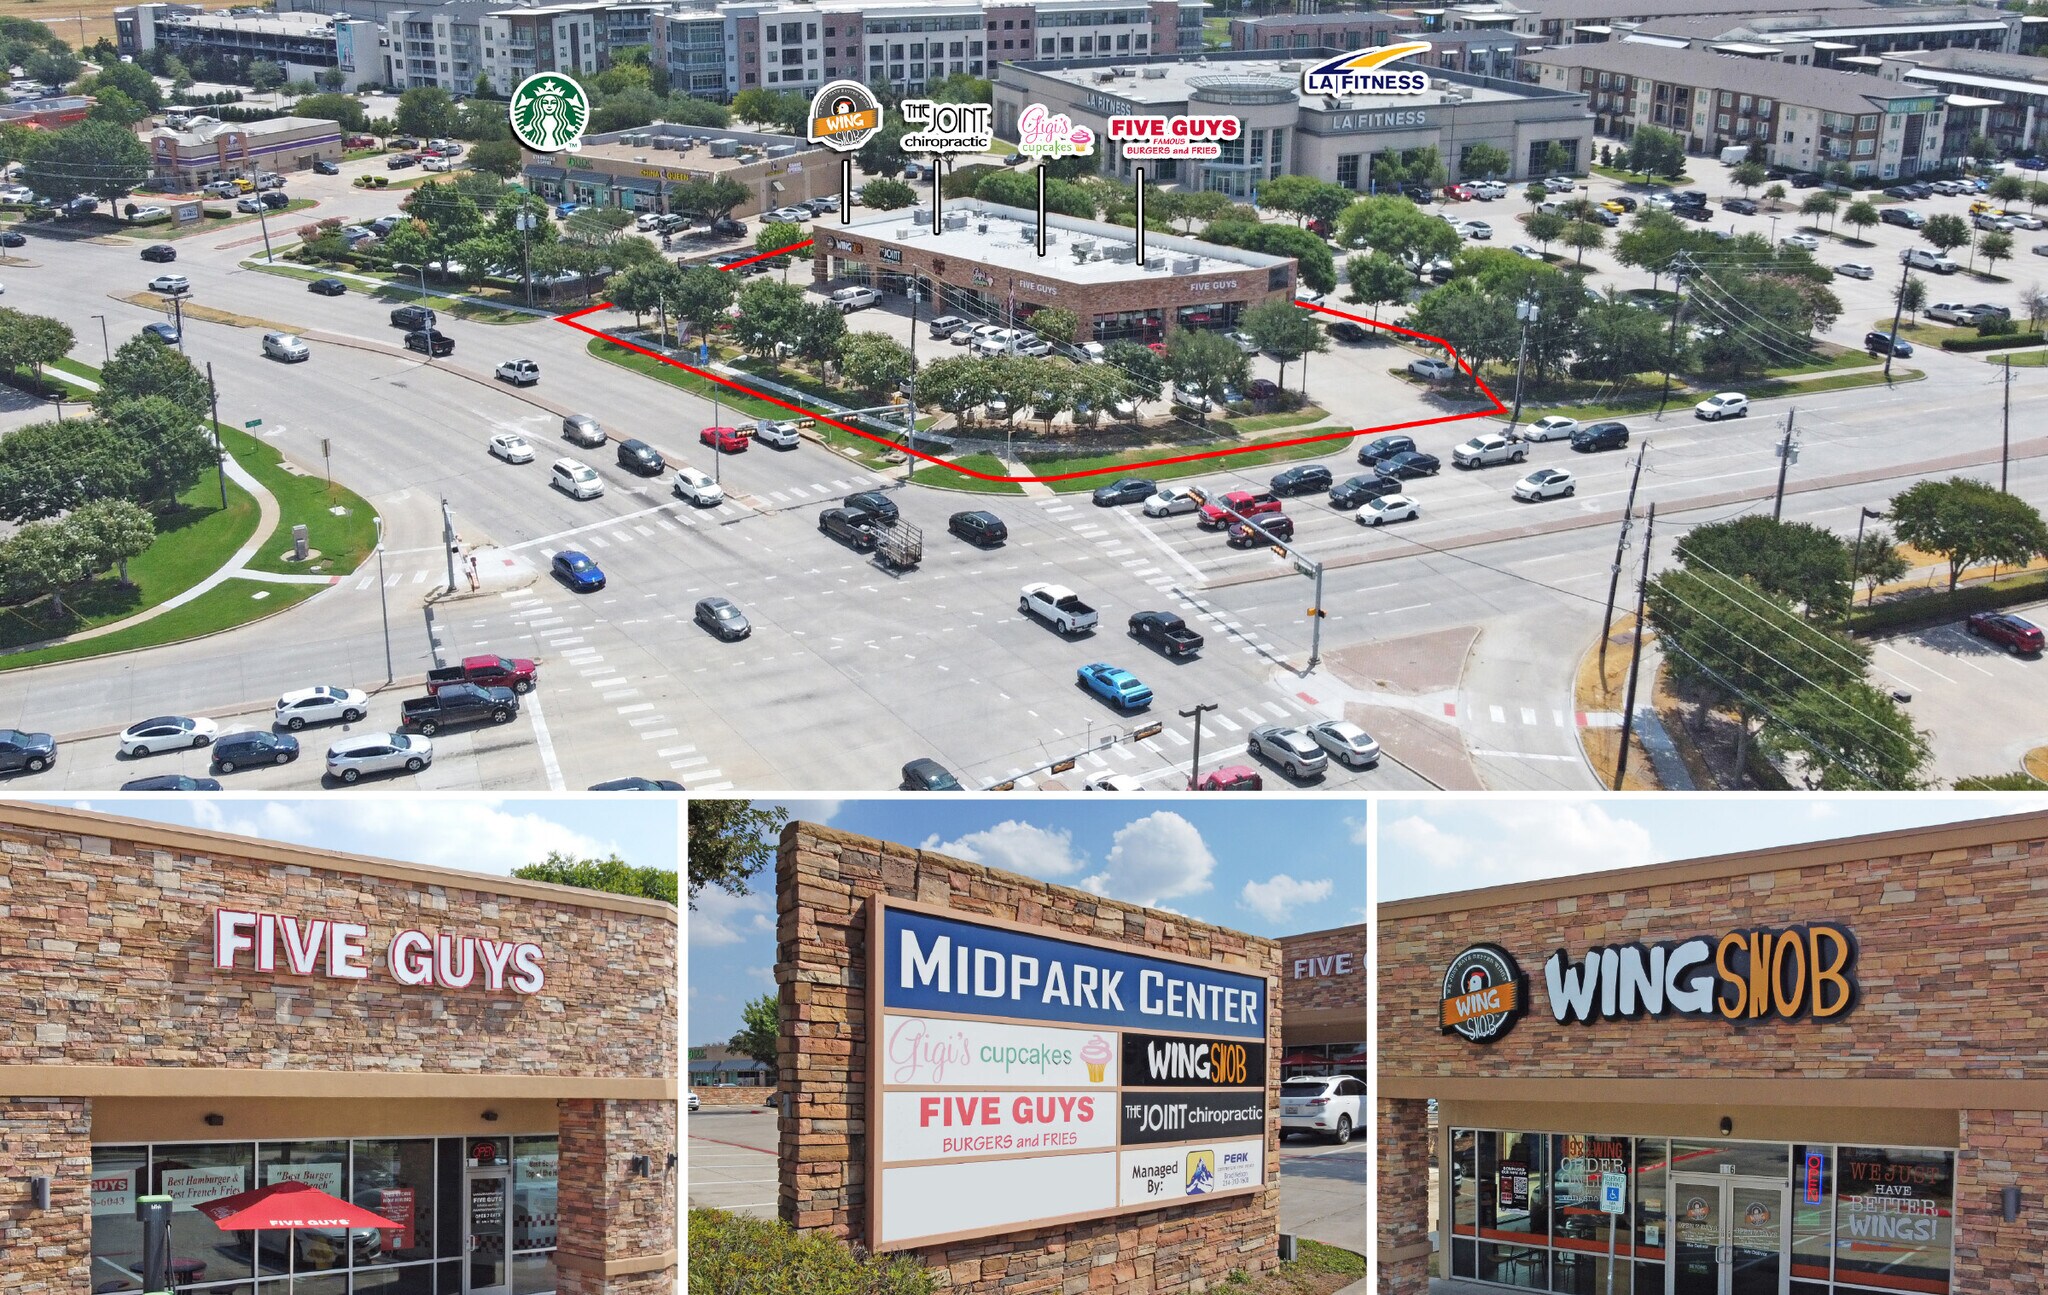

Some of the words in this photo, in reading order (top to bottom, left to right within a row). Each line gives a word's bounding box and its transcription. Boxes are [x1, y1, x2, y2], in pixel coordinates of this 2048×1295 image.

[1099, 96, 1132, 116] FITNESS
[1332, 116, 1352, 129] LA
[1358, 111, 1426, 128] FITNESS
[667, 172, 689, 181] QUEEN
[1019, 279, 1035, 291] FIVE
[1036, 283, 1057, 296] GUYS
[1190, 282, 1210, 292] FIVE
[1212, 280, 1238, 290] GUYS
[214, 908, 368, 979] FIVE
[387, 929, 545, 994] GUYS
[1294, 953, 1351, 980] FIVE
[900, 928, 1125, 1012] MIDPARK
[1139, 969, 1258, 1026] CENTER
[1456, 989, 1500, 1017] WING
[1467, 1013, 1497, 1040] SNOB
[888, 1018, 971, 1084] Gigi's
[980, 1043, 1072, 1075] cupcakes
[920, 1096, 1000, 1127] FIVE
[1012, 1096, 1094, 1125] GUYS
[1125, 1105, 1141, 1119] THE
[1140, 1104, 1188, 1132] JOINT
[1188, 1105, 1263, 1124] chiropractic
[943, 1134, 1012, 1153] BURGERS
[1016, 1134, 1039, 1148] and
[1043, 1131, 1078, 1146] FRIES
[473, 1143, 495, 1160] OPEN
[1223, 1152, 1249, 1165] PEAK
[1132, 1161, 1178, 1179] Managed
[1561, 1157, 1627, 1174] ORDER
[1849, 1162, 1881, 1181] WE
[1884, 1164, 1939, 1185] JUST
[91, 1179, 126, 1191] GUYS
[167, 1176, 184, 1187] Best
[186, 1174, 231, 1186] Hamburger
[232, 1172, 239, 1180] &
[303, 1171, 334, 1181] Burger
[1561, 1173, 1601, 1188] ONLI
[1807, 1156, 1821, 1202] OPEN
[167, 1189, 185, 1199] Best
[187, 1187, 217, 1198] French
[1147, 1180, 1163, 1195] By:
[1875, 1184, 1912, 1196] HAVE
[1849, 1195, 1939, 1217] BETTER
[1848, 1213, 1938, 1241] WINGS!
